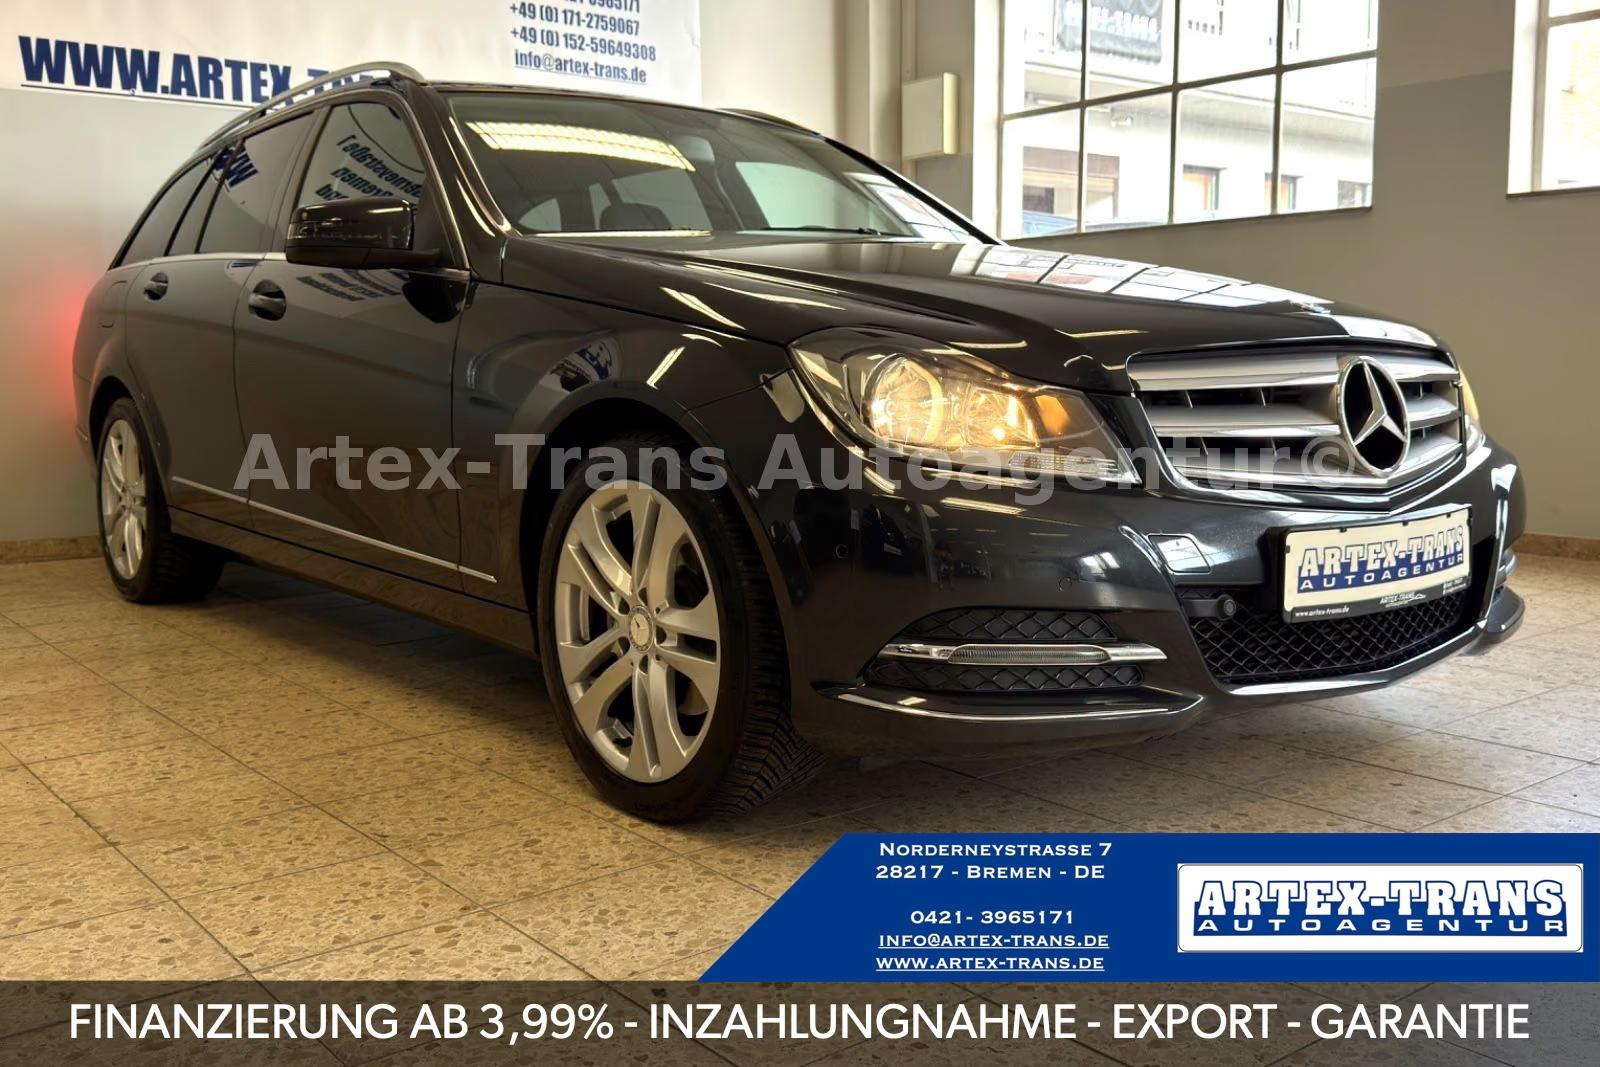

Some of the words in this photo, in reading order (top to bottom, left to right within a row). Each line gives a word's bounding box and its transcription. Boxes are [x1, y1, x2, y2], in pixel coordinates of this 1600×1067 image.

[510, 2, 536, 19] +49
[540, 5, 558, 23] (0)
[562, 9, 640, 36] 171-2759067
[511, 26, 537, 44] +49
[541, 29, 559, 47] (0)
[563, 33, 656, 62] 152-59649308
[514, 49, 647, 83] info@artex-trans.de
[1300, 525, 1465, 577] ARTEX-TRANS
[1299, 553, 1464, 591] AUTOAGENTUR
